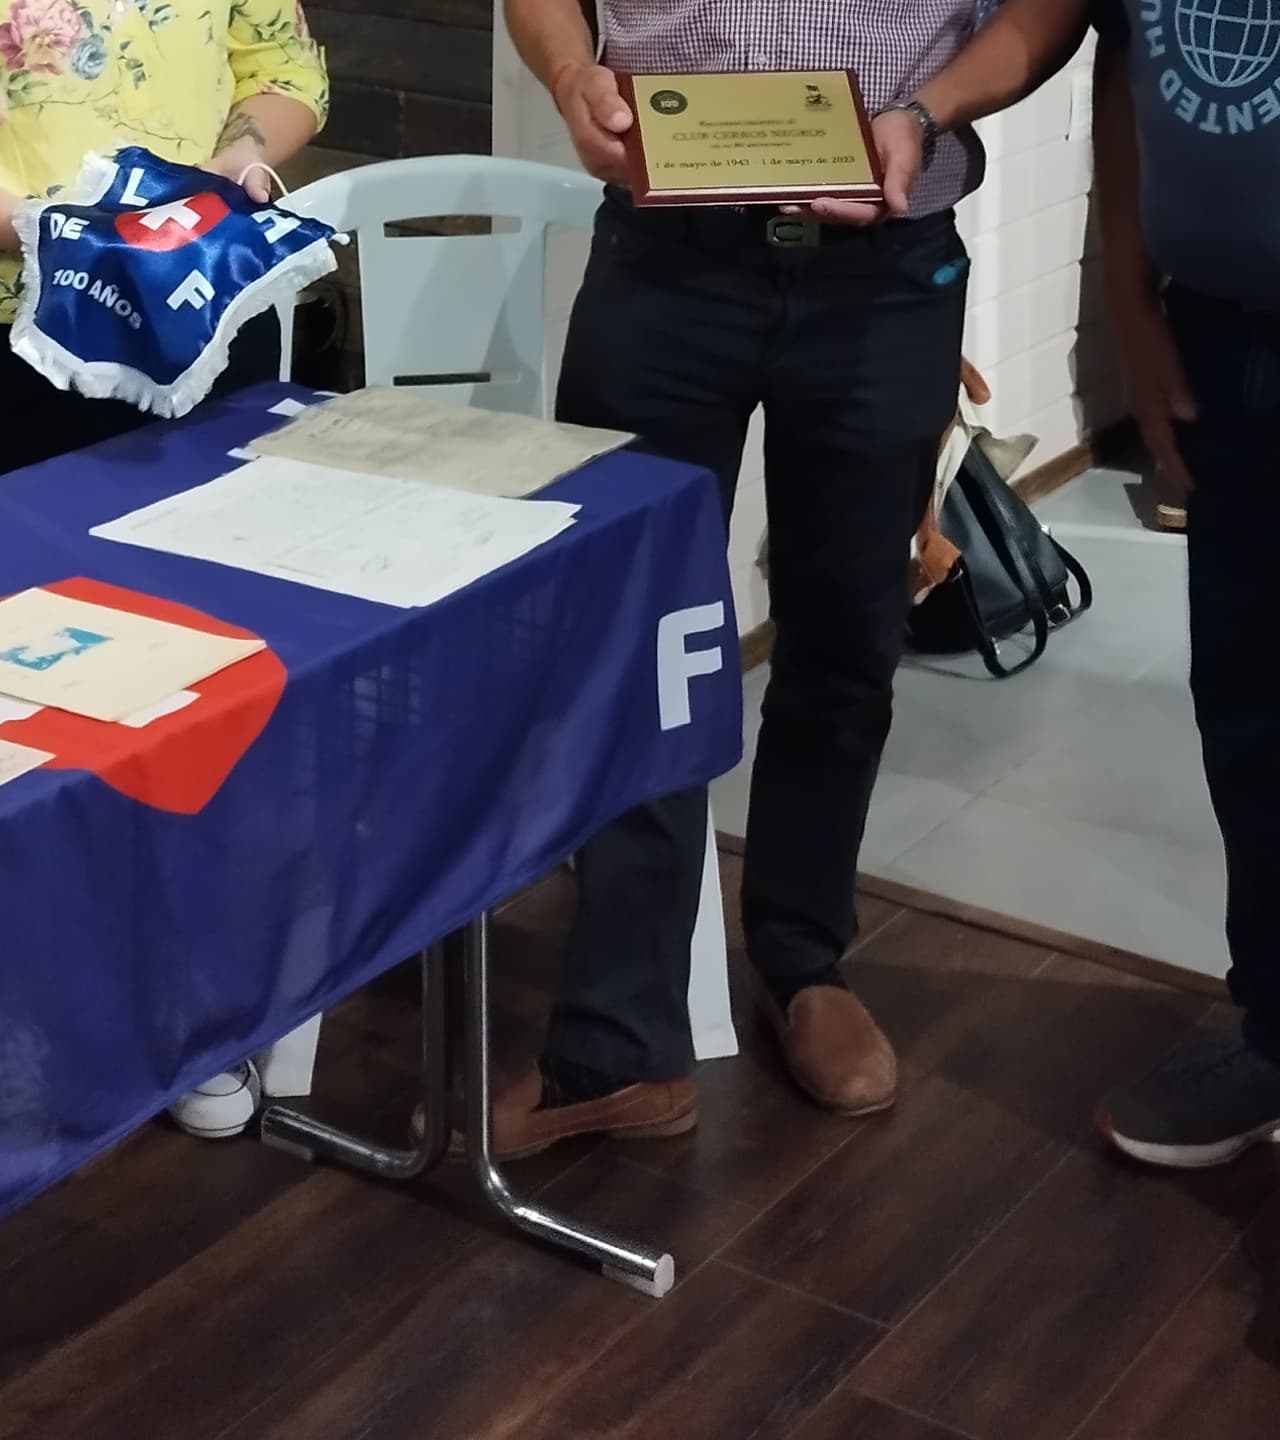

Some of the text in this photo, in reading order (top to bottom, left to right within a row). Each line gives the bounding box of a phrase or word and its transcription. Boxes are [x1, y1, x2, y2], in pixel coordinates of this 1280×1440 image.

[663, 160, 676, 169] de
[679, 161, 707, 171] mayo
[709, 159, 722, 168] de
[725, 159, 751, 167] 1943
[769, 157, 783, 166] de
[785, 157, 813, 168] mayo
[815, 156, 829, 165] de
[832, 155, 857, 165] 2023
[119, 168, 149, 207] L
[49, 211, 91, 240] DE
[51, 268, 144, 330] 100 AÑOS
[657, 601, 725, 731] F
